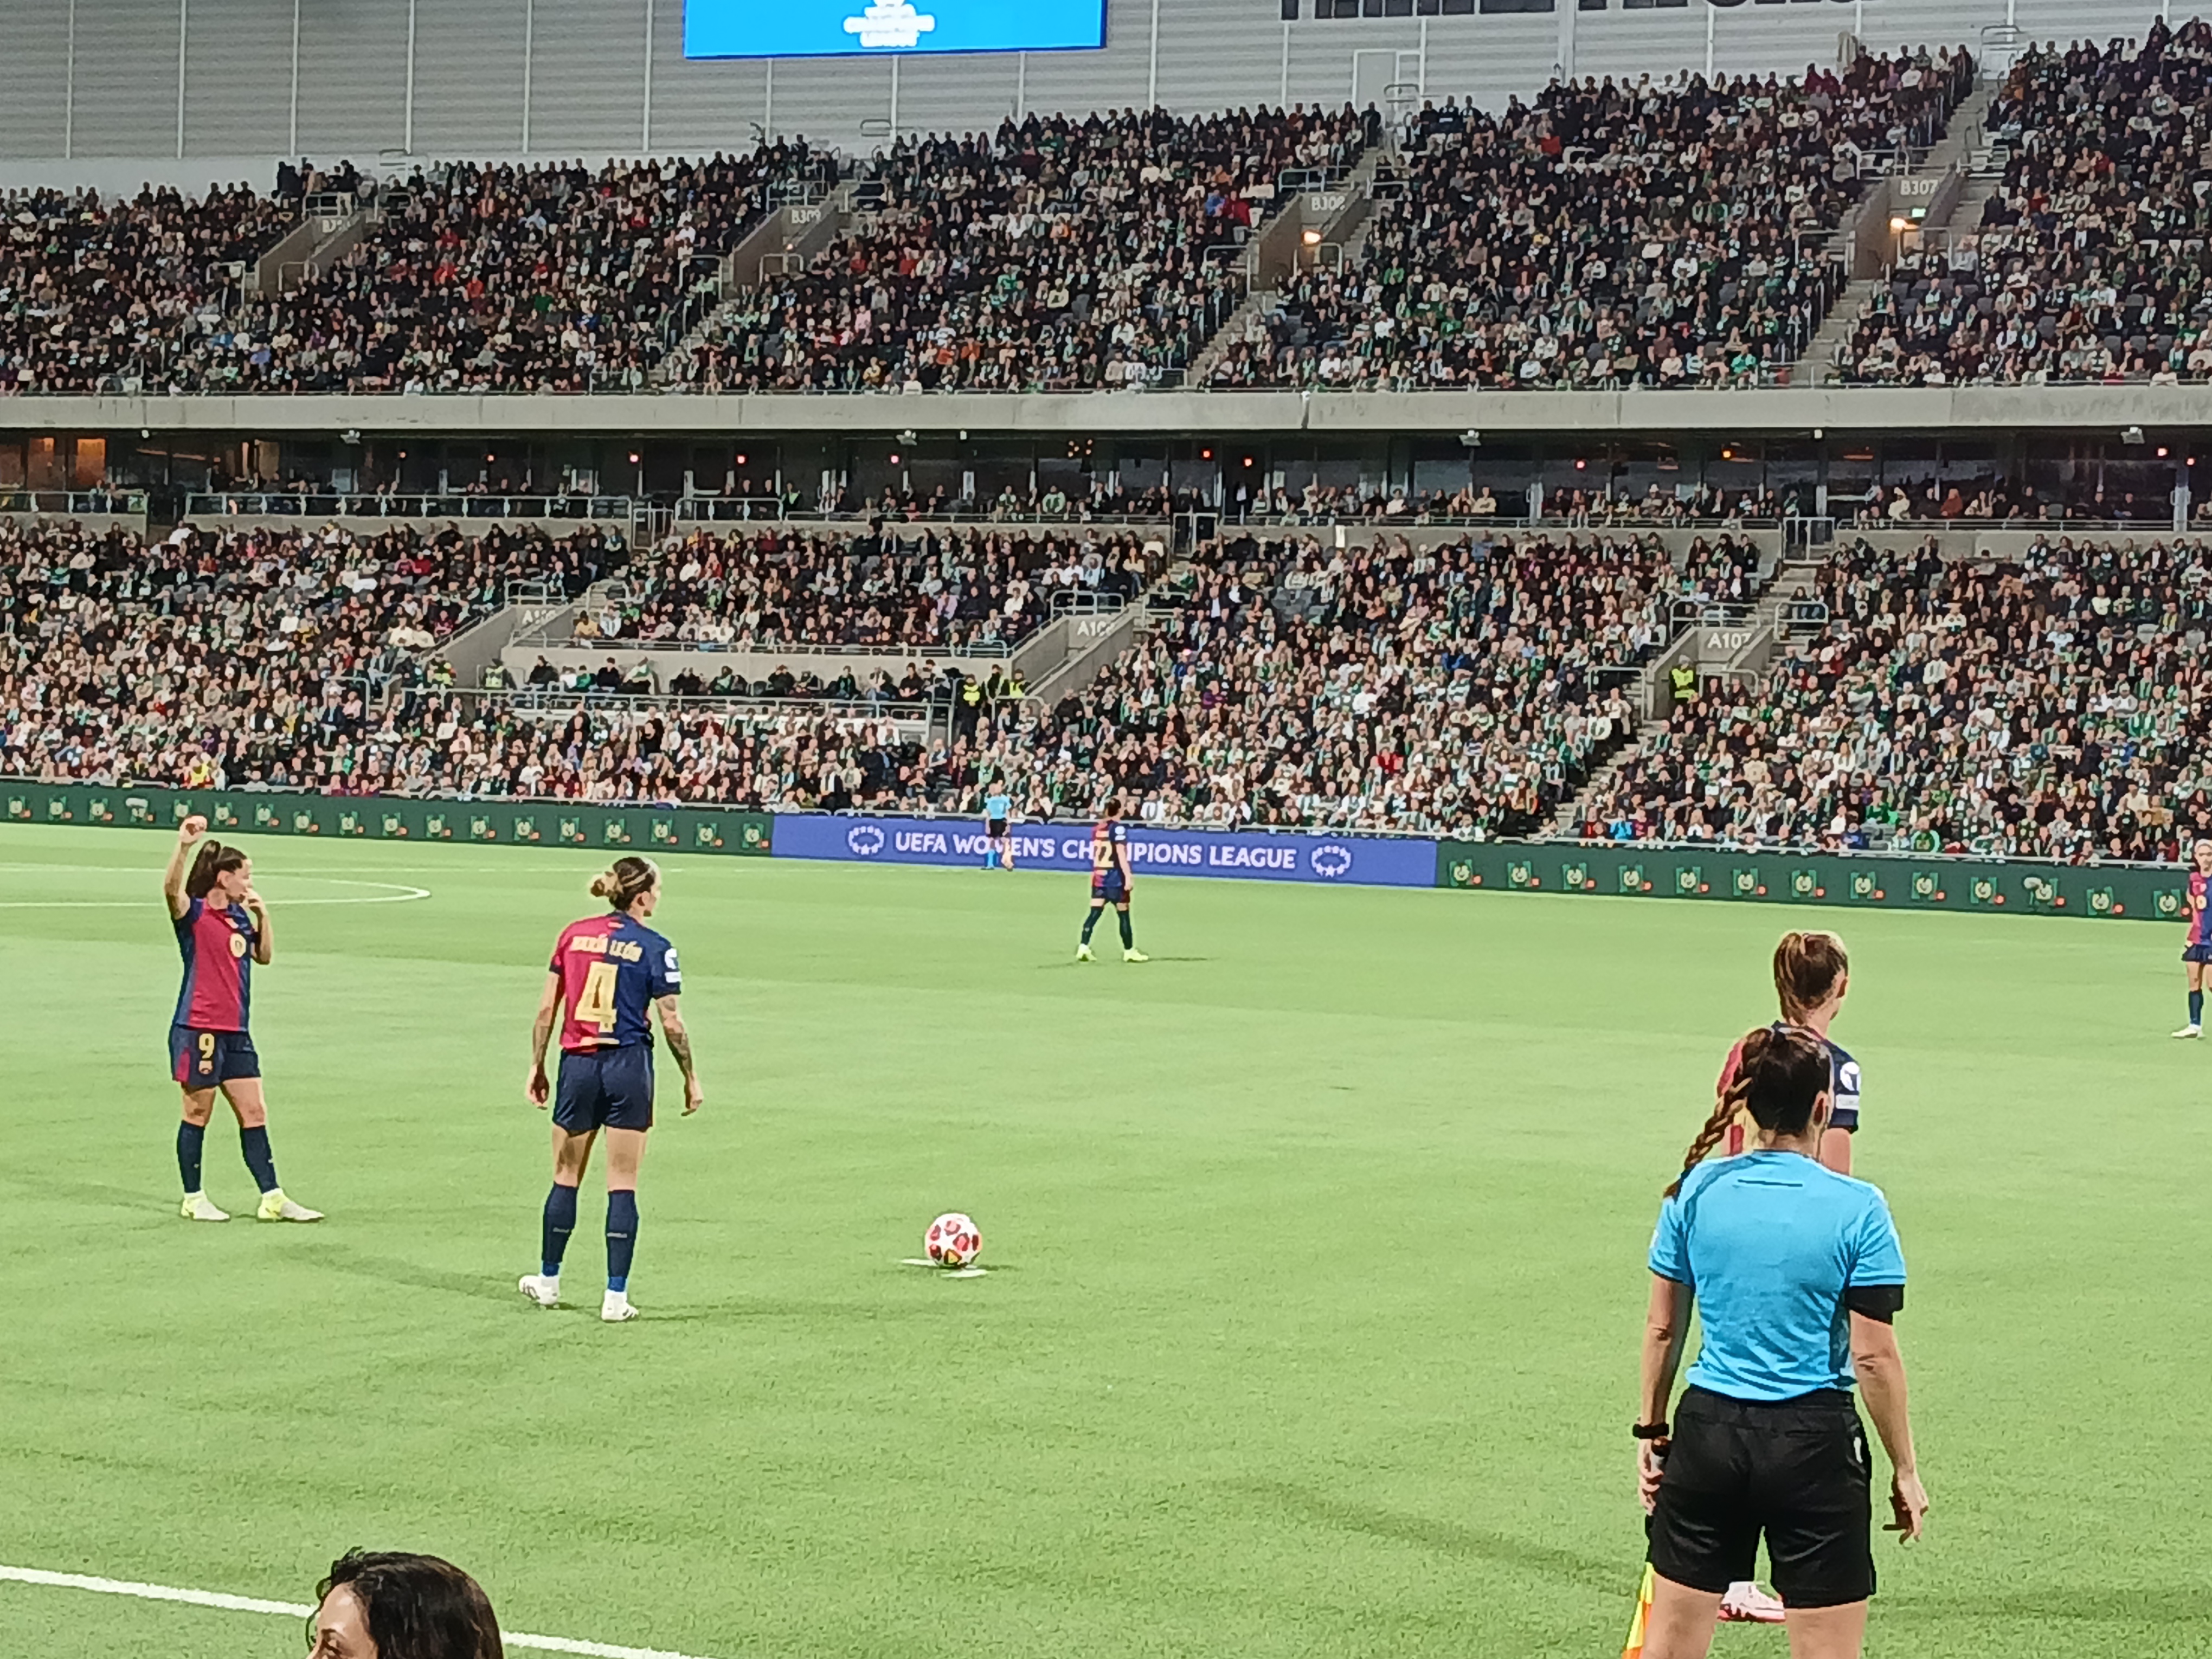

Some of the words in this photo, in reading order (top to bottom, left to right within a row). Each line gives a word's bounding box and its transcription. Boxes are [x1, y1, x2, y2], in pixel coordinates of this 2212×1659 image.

[1900, 179, 1939, 195] B307
[1708, 632, 1752, 650] A107
[895, 831, 947, 854] UEFA
[1062, 839, 1202, 866] CHPIONS
[1210, 845, 1297, 869] LEAGUE
[575, 961, 618, 1033] 4
[199, 1033, 215, 1059] 9
